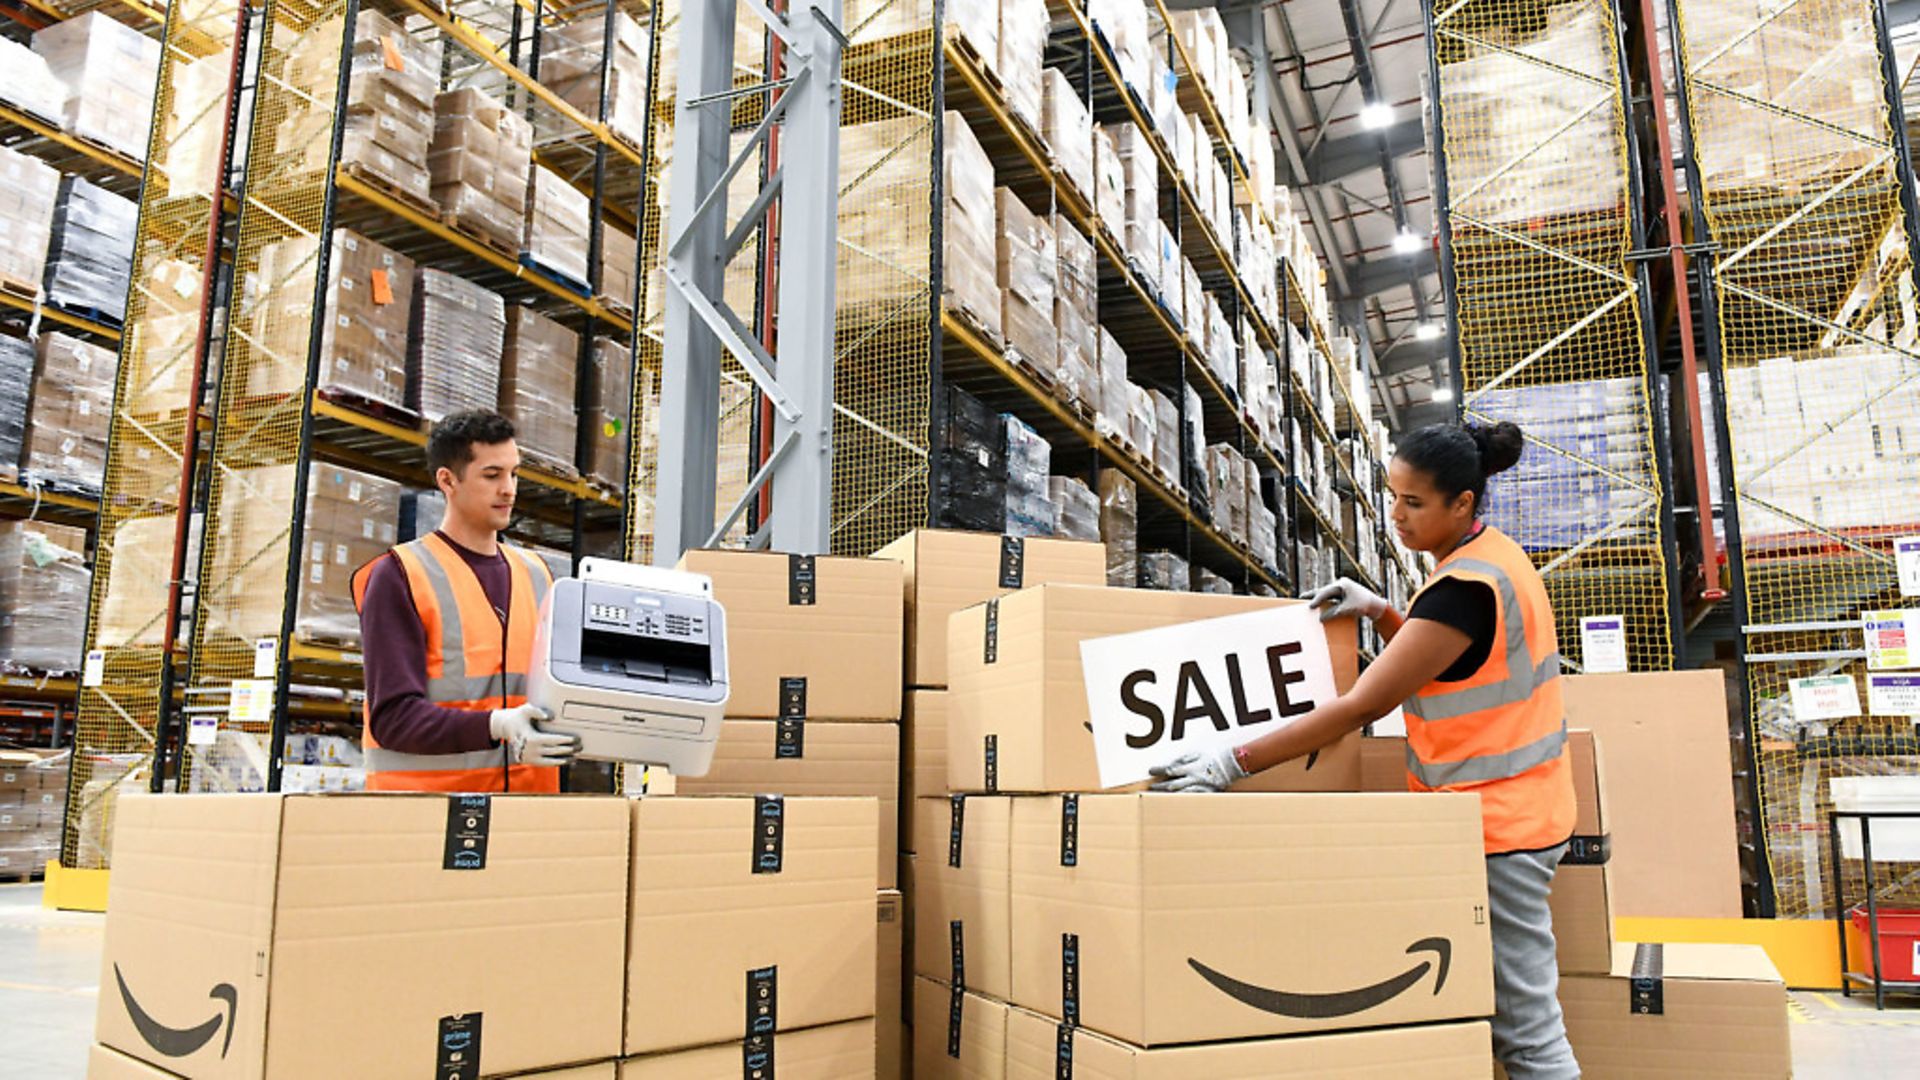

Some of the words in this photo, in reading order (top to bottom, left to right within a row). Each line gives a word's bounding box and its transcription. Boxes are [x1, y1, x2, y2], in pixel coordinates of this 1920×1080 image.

[1120, 641, 1315, 748] SALE
[454, 859, 481, 869] prime
[444, 1031, 472, 1043] prime
